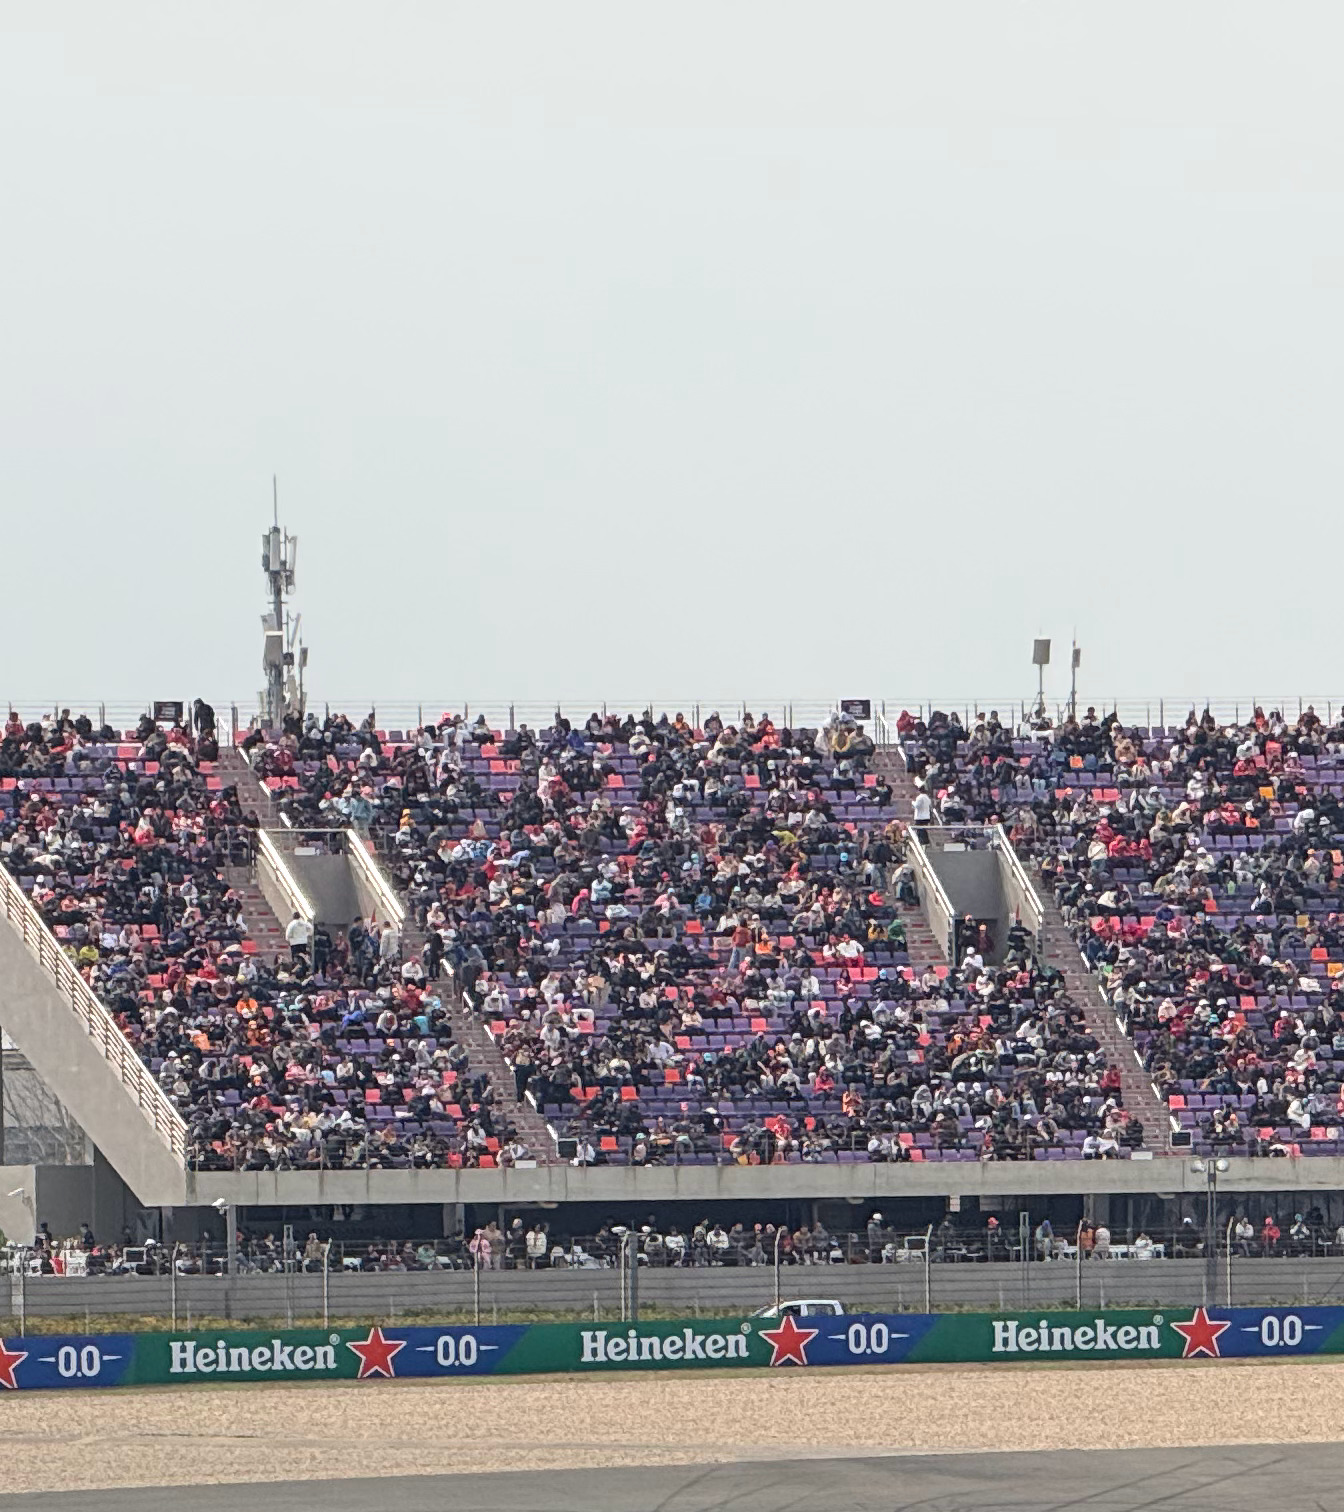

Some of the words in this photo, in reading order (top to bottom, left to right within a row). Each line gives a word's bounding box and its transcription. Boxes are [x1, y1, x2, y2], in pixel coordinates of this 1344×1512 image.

[581, 1328, 749, 1362] Heineken
[992, 1319, 1162, 1352] Heineken
[169, 1340, 338, 1374] Heineken
